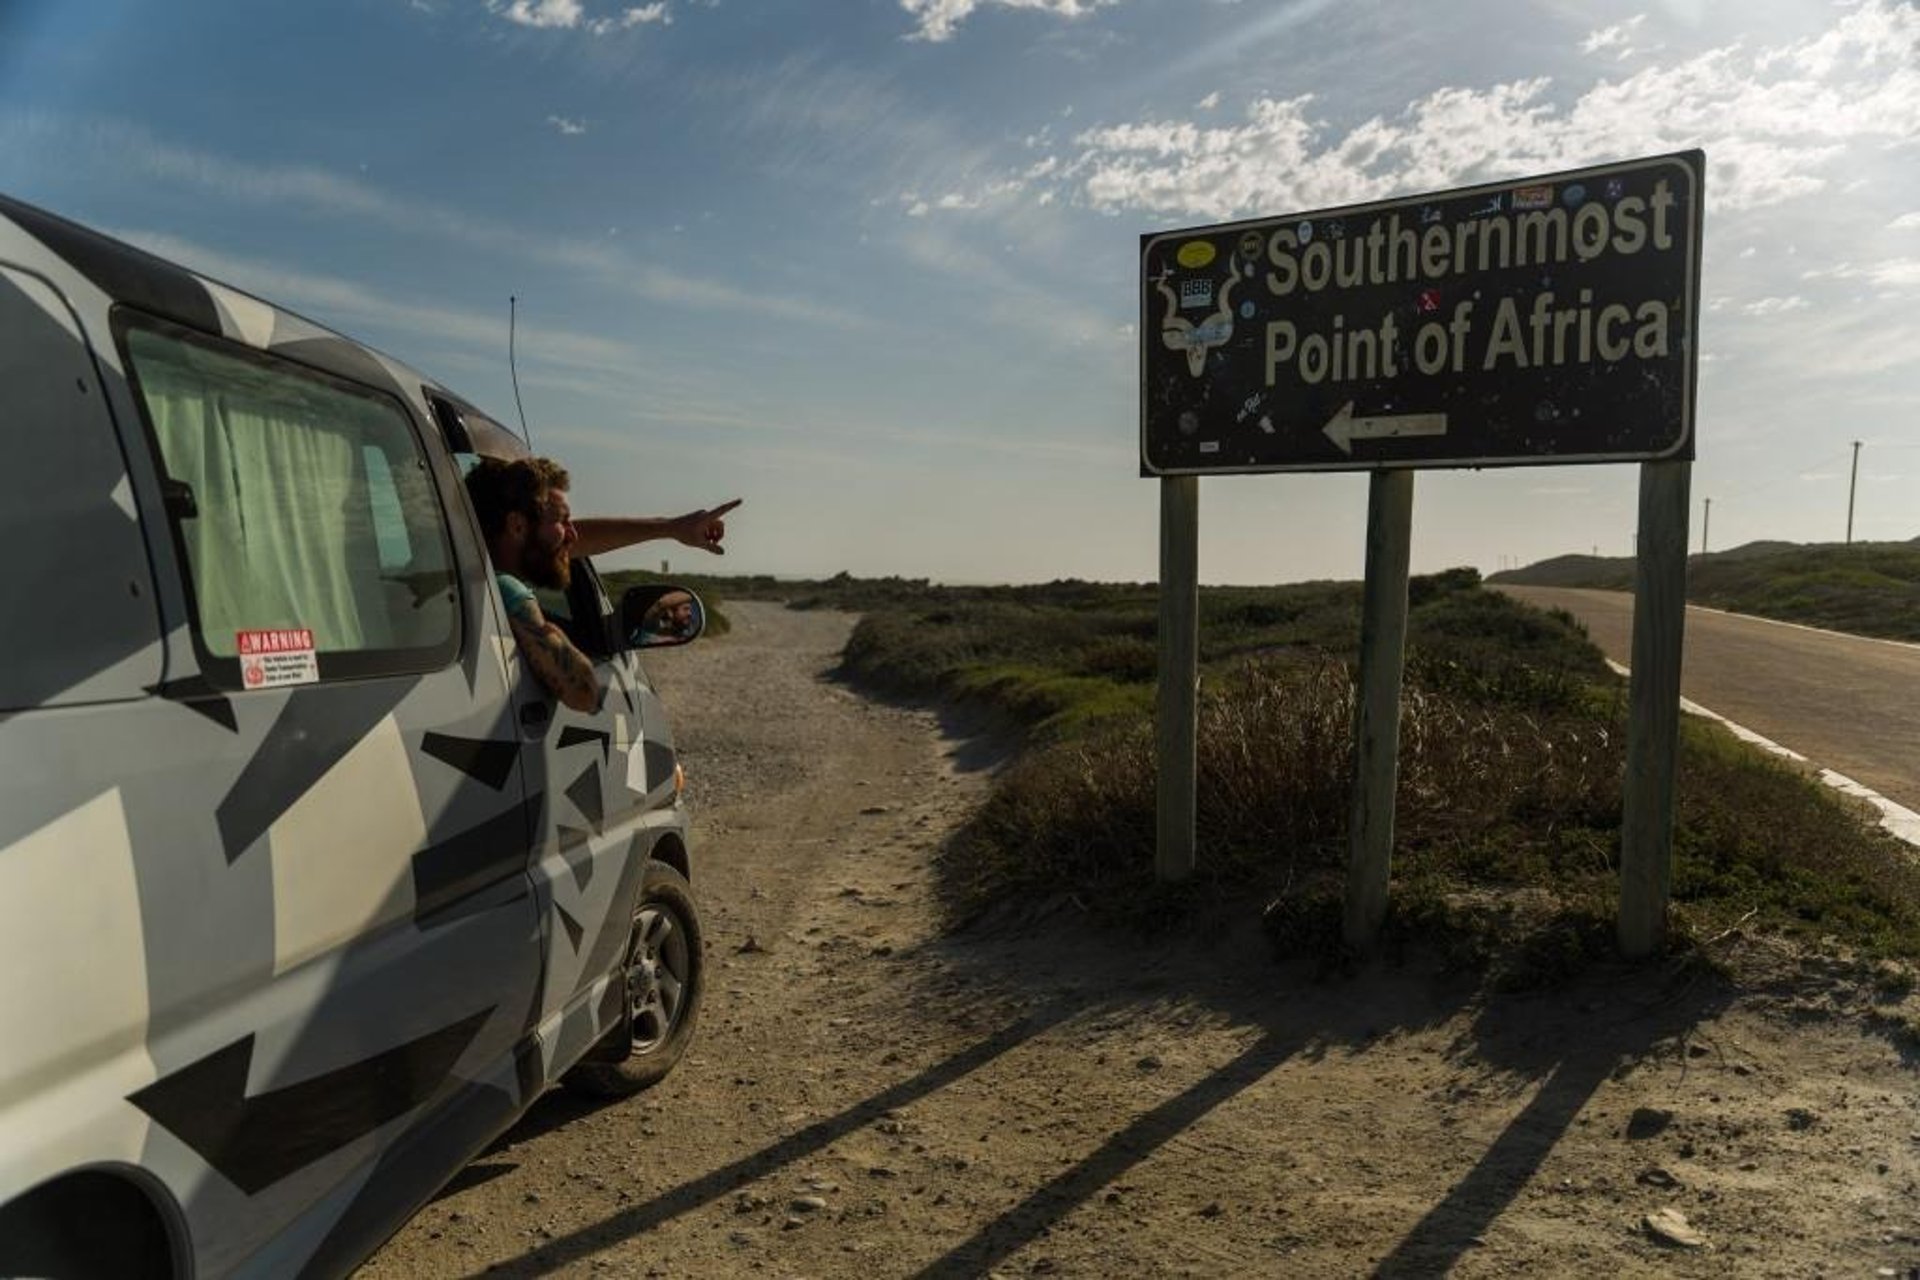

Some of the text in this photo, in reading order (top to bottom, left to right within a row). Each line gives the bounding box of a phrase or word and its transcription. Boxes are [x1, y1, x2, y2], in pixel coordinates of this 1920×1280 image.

[1266, 178, 1674, 296] Southernmost
[1265, 289, 1669, 386] Point of Africa
[249, 630, 311, 652] WARNING
